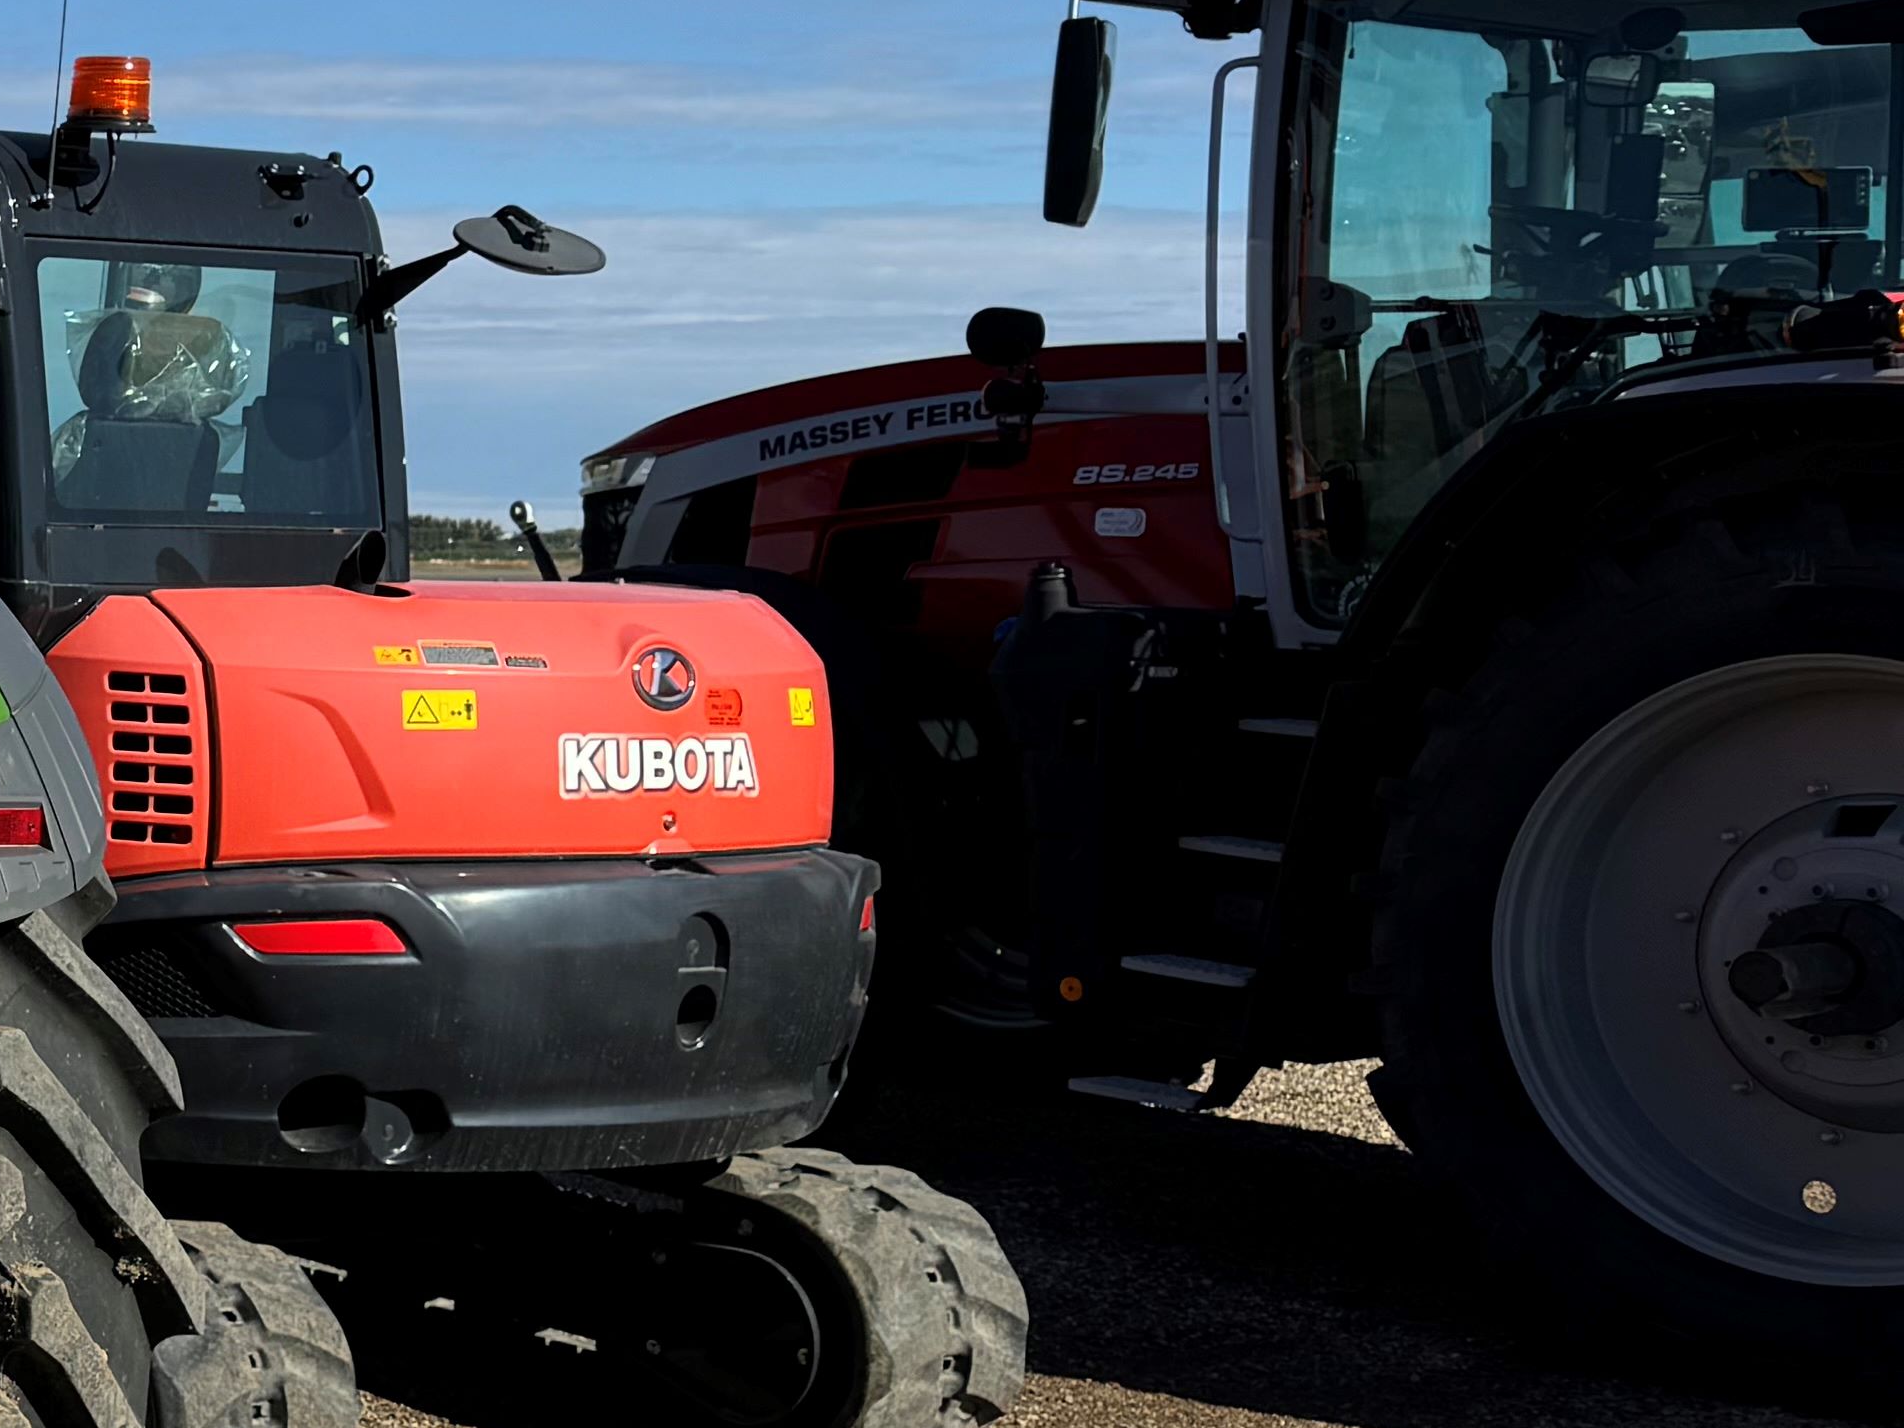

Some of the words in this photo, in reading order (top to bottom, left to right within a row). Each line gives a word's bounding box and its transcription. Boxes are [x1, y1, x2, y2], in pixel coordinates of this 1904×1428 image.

[759, 411, 894, 462] MASSEY
[1073, 462, 1200, 485] 8S.245
[563, 736, 757, 793] KUBOTA
